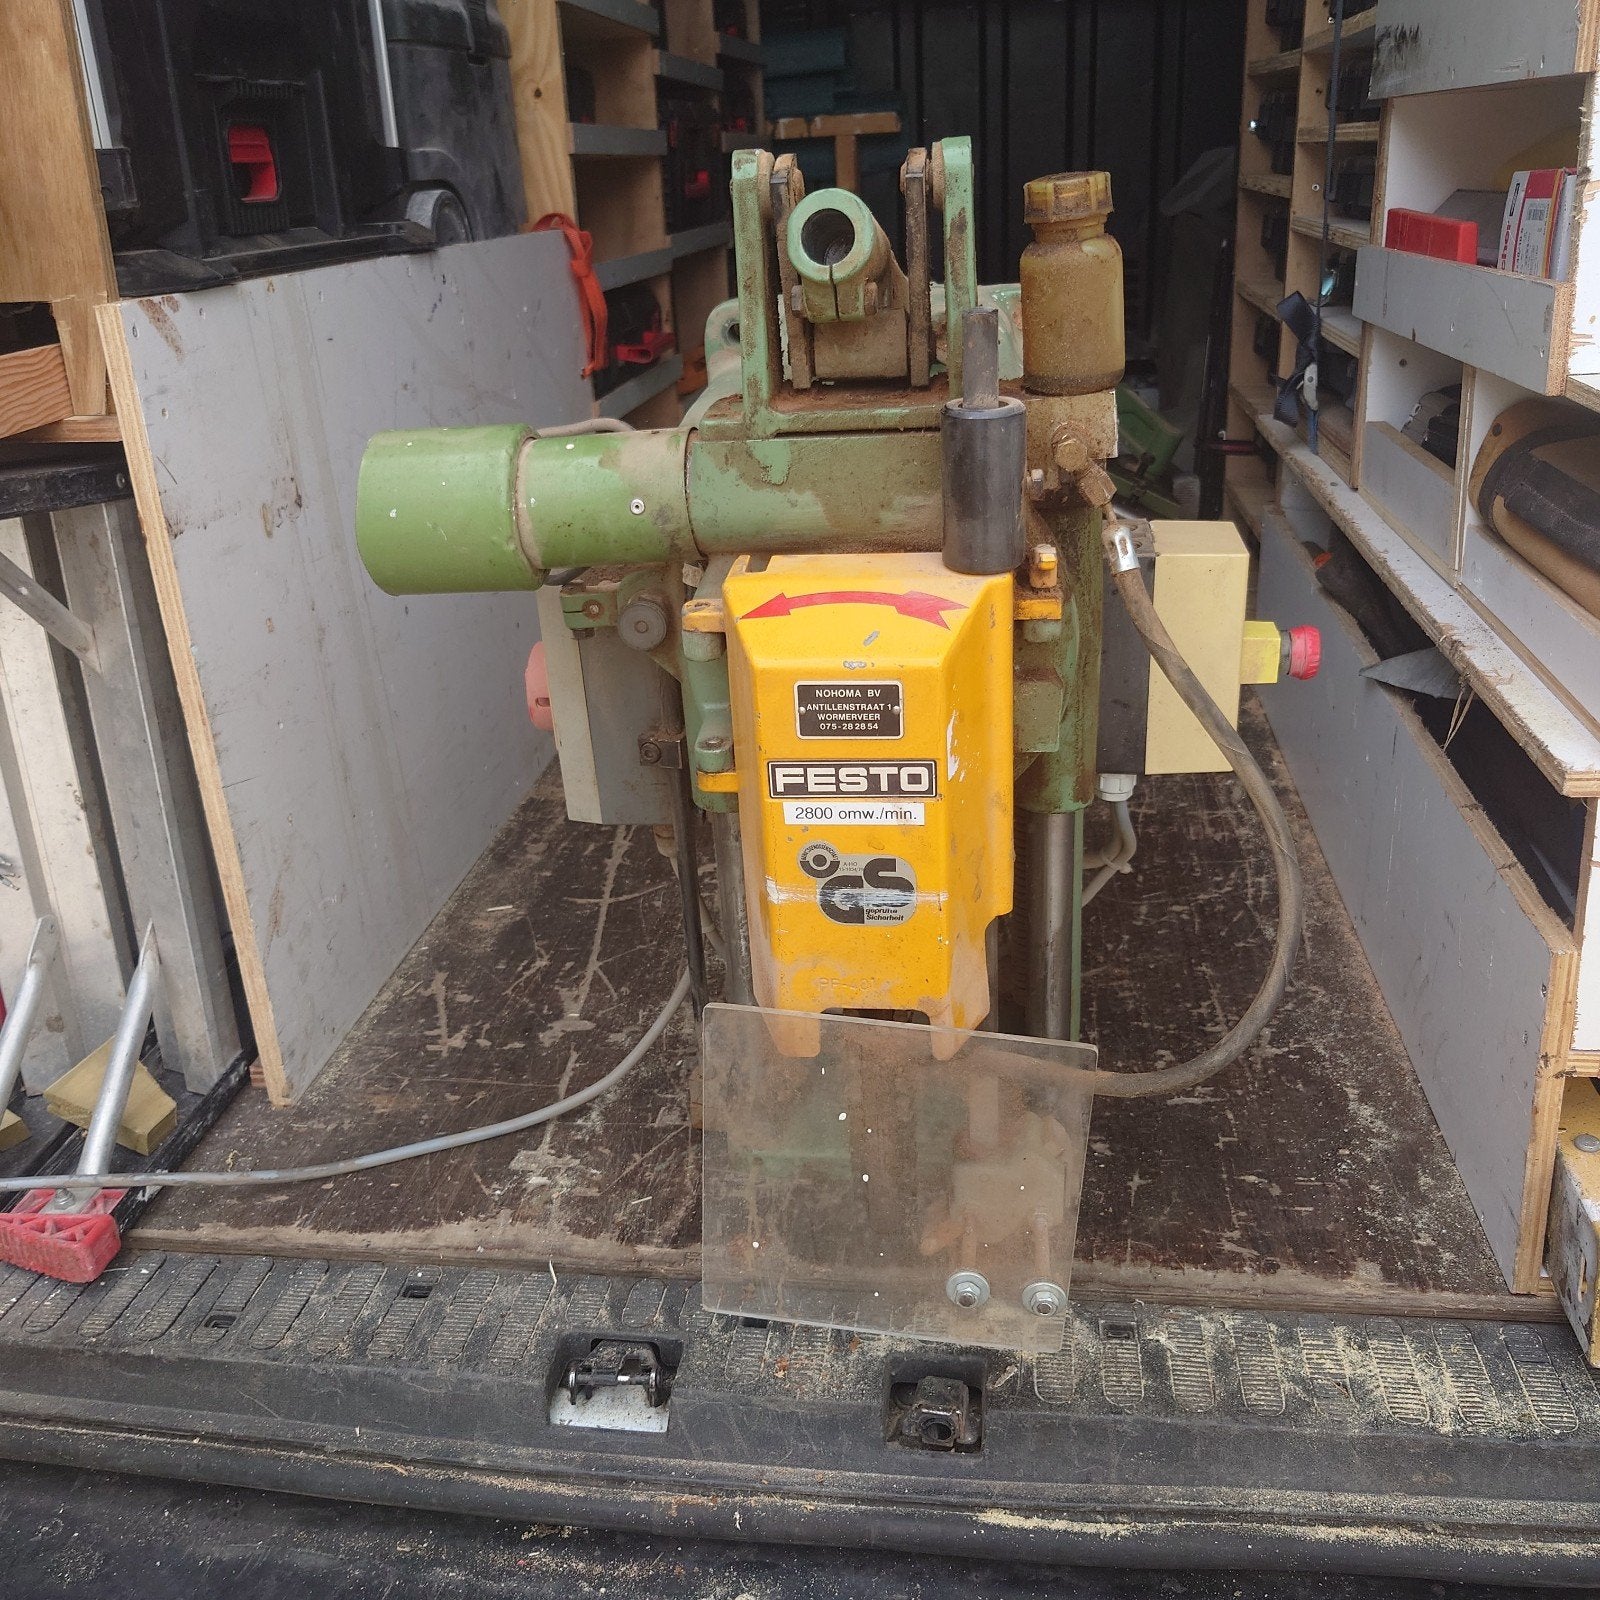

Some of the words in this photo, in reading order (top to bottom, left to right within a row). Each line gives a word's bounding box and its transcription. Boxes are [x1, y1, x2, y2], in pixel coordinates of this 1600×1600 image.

[815, 689, 862, 698] NOHOMA
[867, 689, 881, 698] BV
[806, 703, 885, 711] ANTILLENSTRAAT
[886, 703, 892, 711] 1
[817, 713, 881, 721] WORMERVEER
[774, 766, 929, 793] FESTO
[795, 807, 833, 820] 2800
[838, 807, 917, 820] omw./min.
